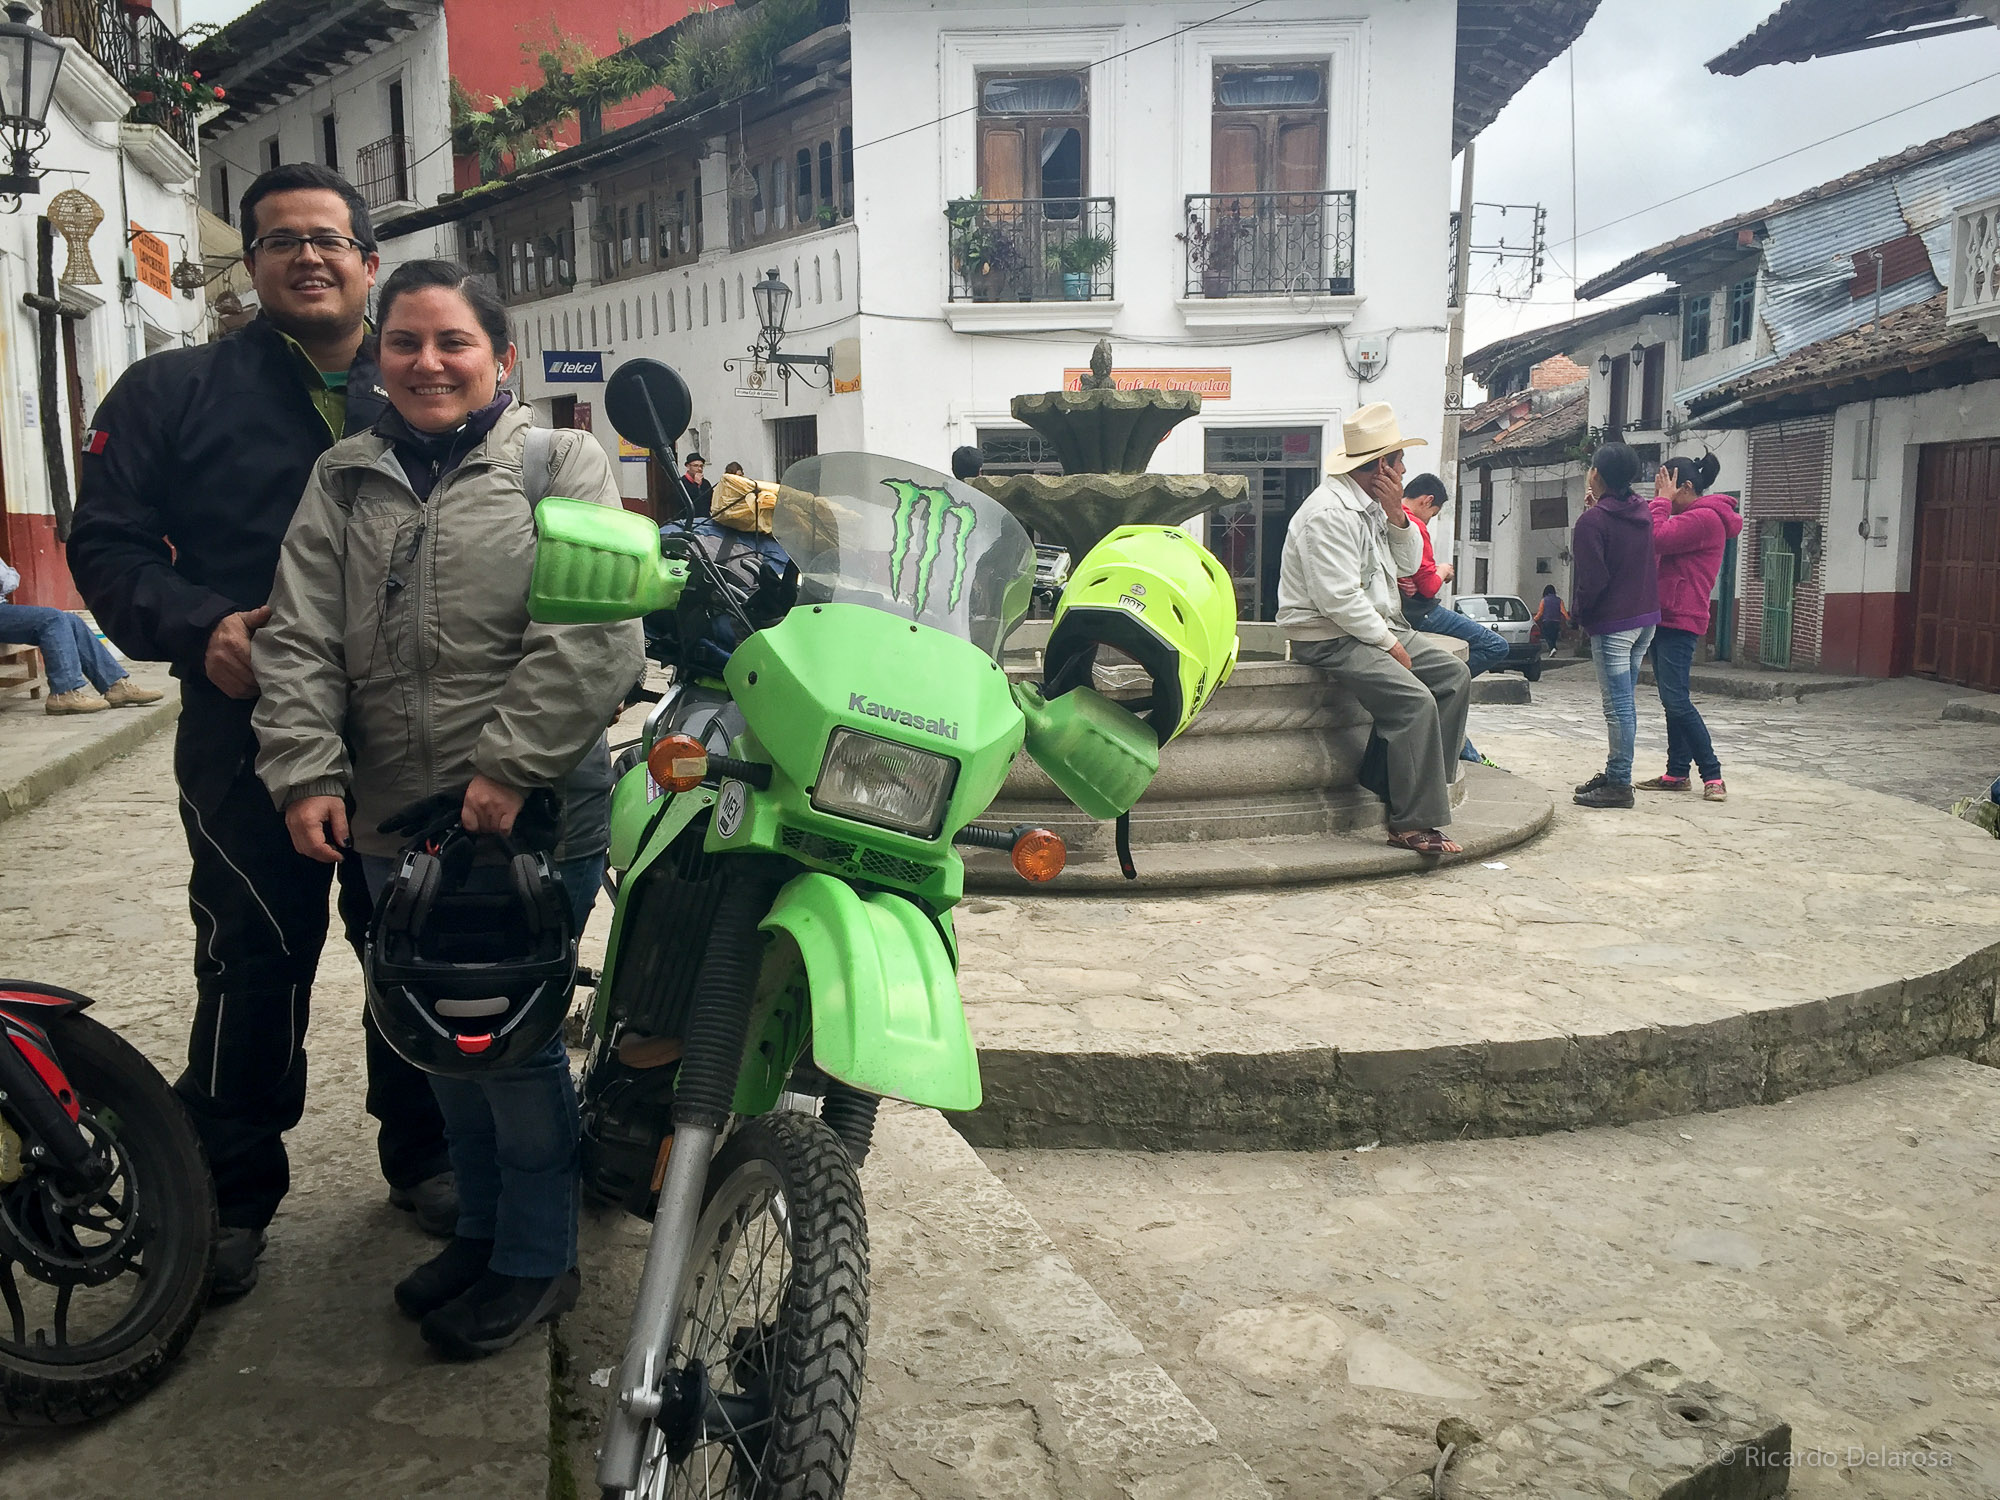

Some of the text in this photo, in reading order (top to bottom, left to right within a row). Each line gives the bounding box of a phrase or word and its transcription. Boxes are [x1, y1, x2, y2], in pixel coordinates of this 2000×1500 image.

[561, 361, 597, 373] telcel
[1147, 378, 1162, 391] de
[1166, 377, 1230, 393] Cuetzalan
[848, 692, 959, 741] Kawasaki
[722, 792, 741, 825] MEX
